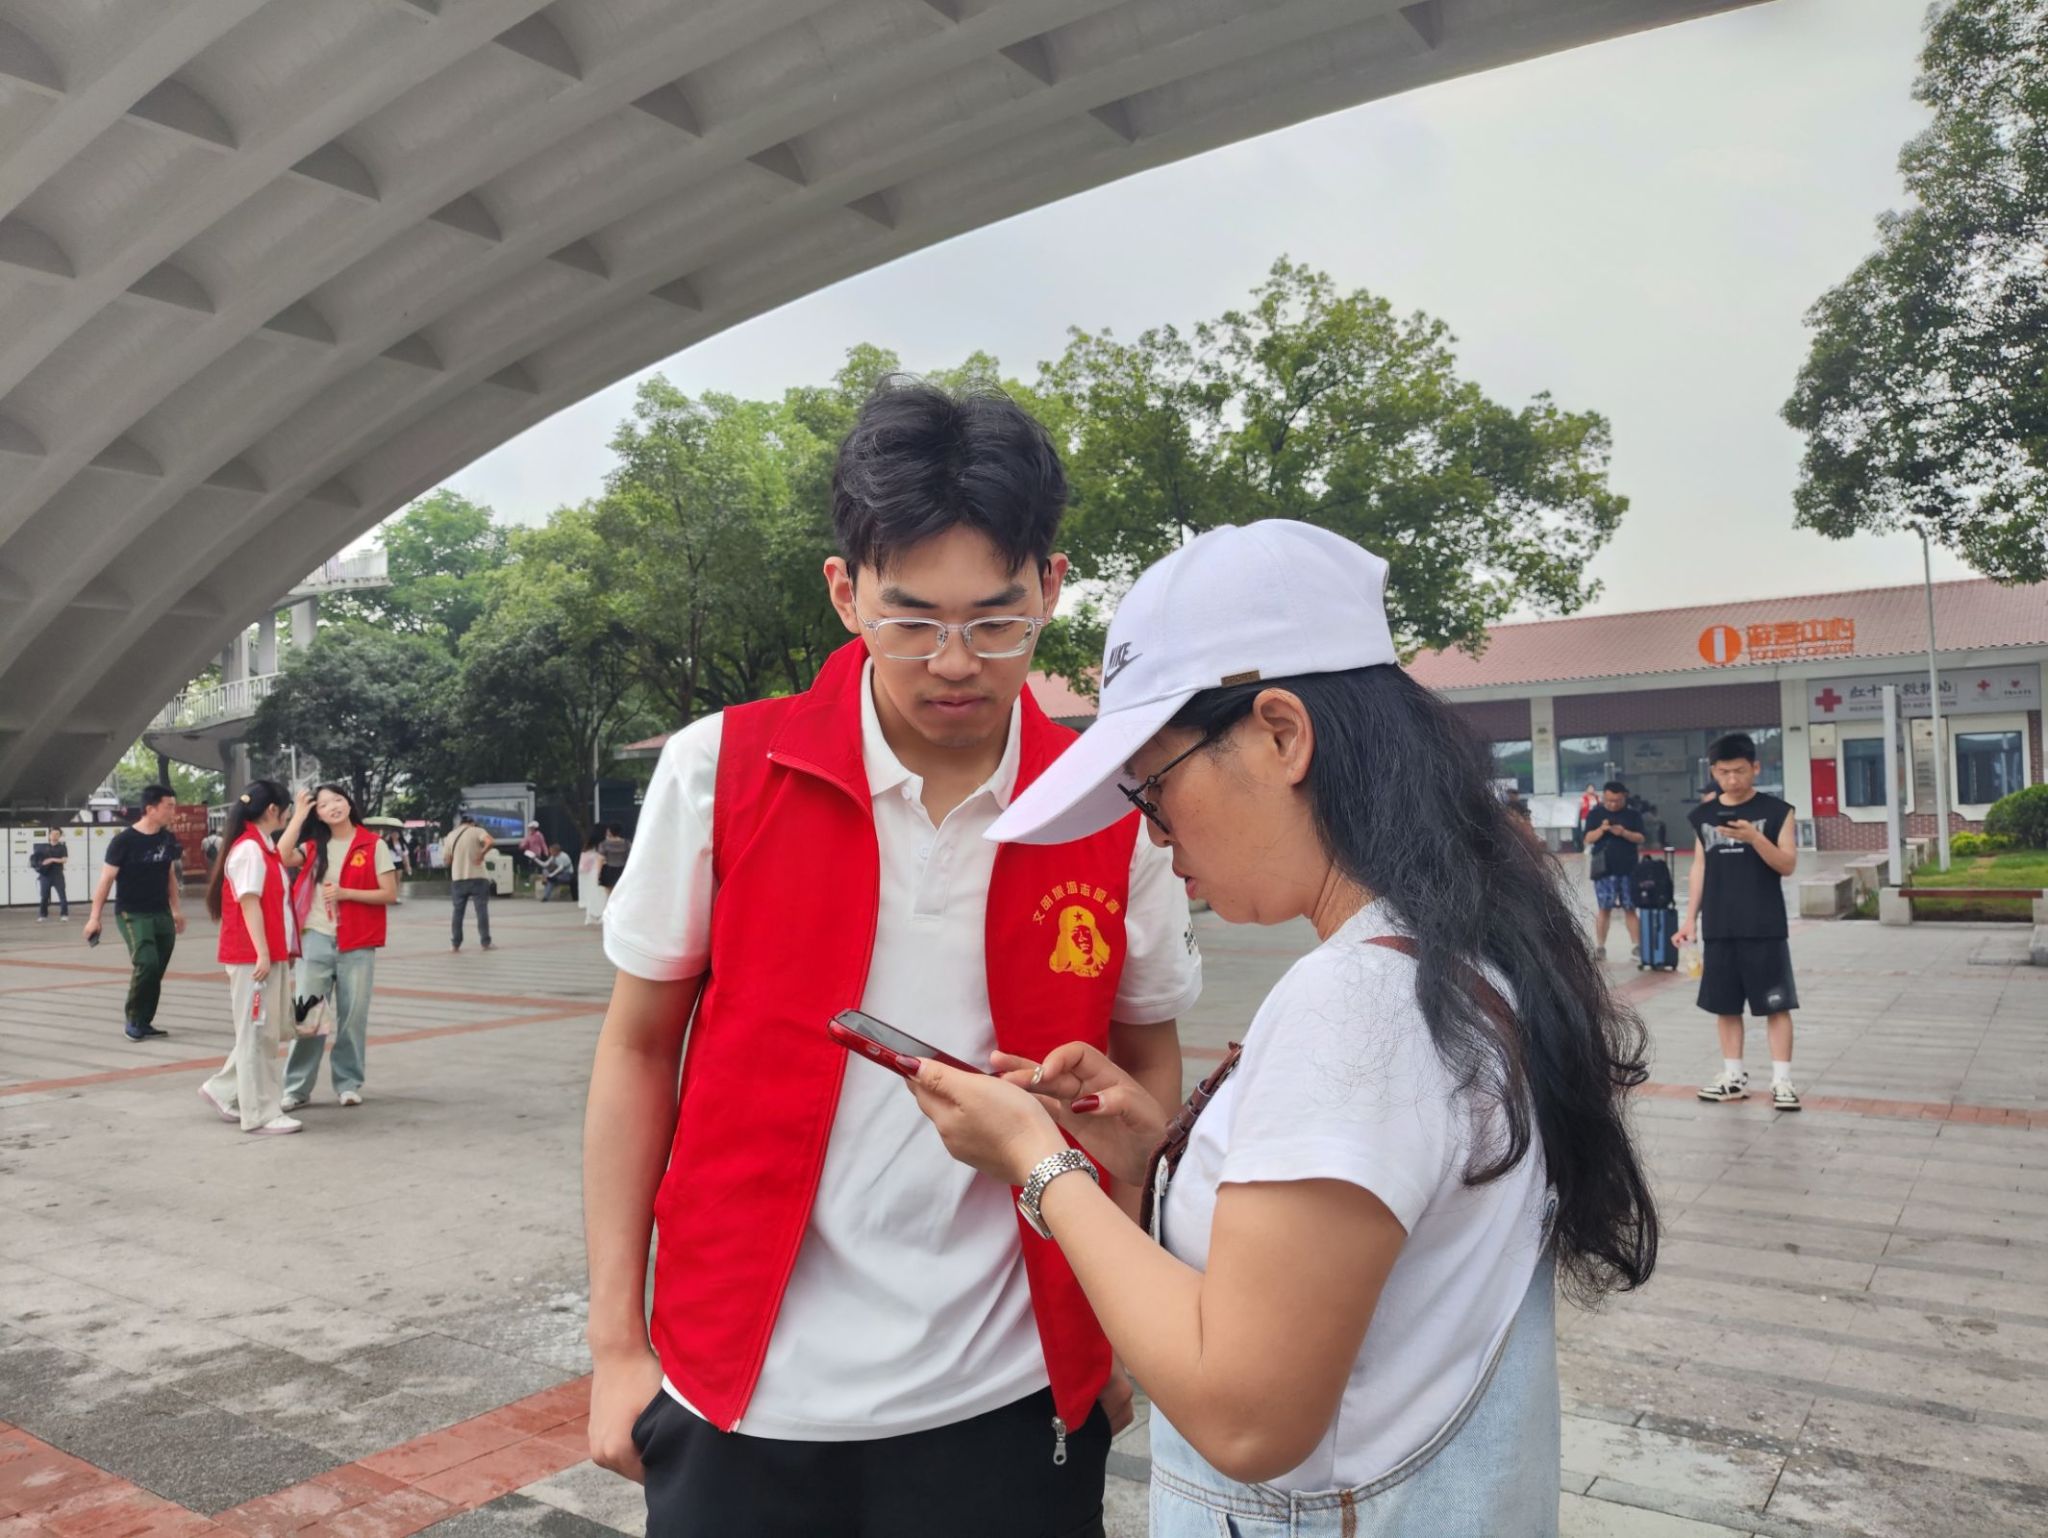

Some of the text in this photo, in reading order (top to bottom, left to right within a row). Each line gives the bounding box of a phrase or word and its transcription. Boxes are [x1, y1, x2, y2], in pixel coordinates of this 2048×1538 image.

[1850, 681, 1951, 699] 红十救护站
